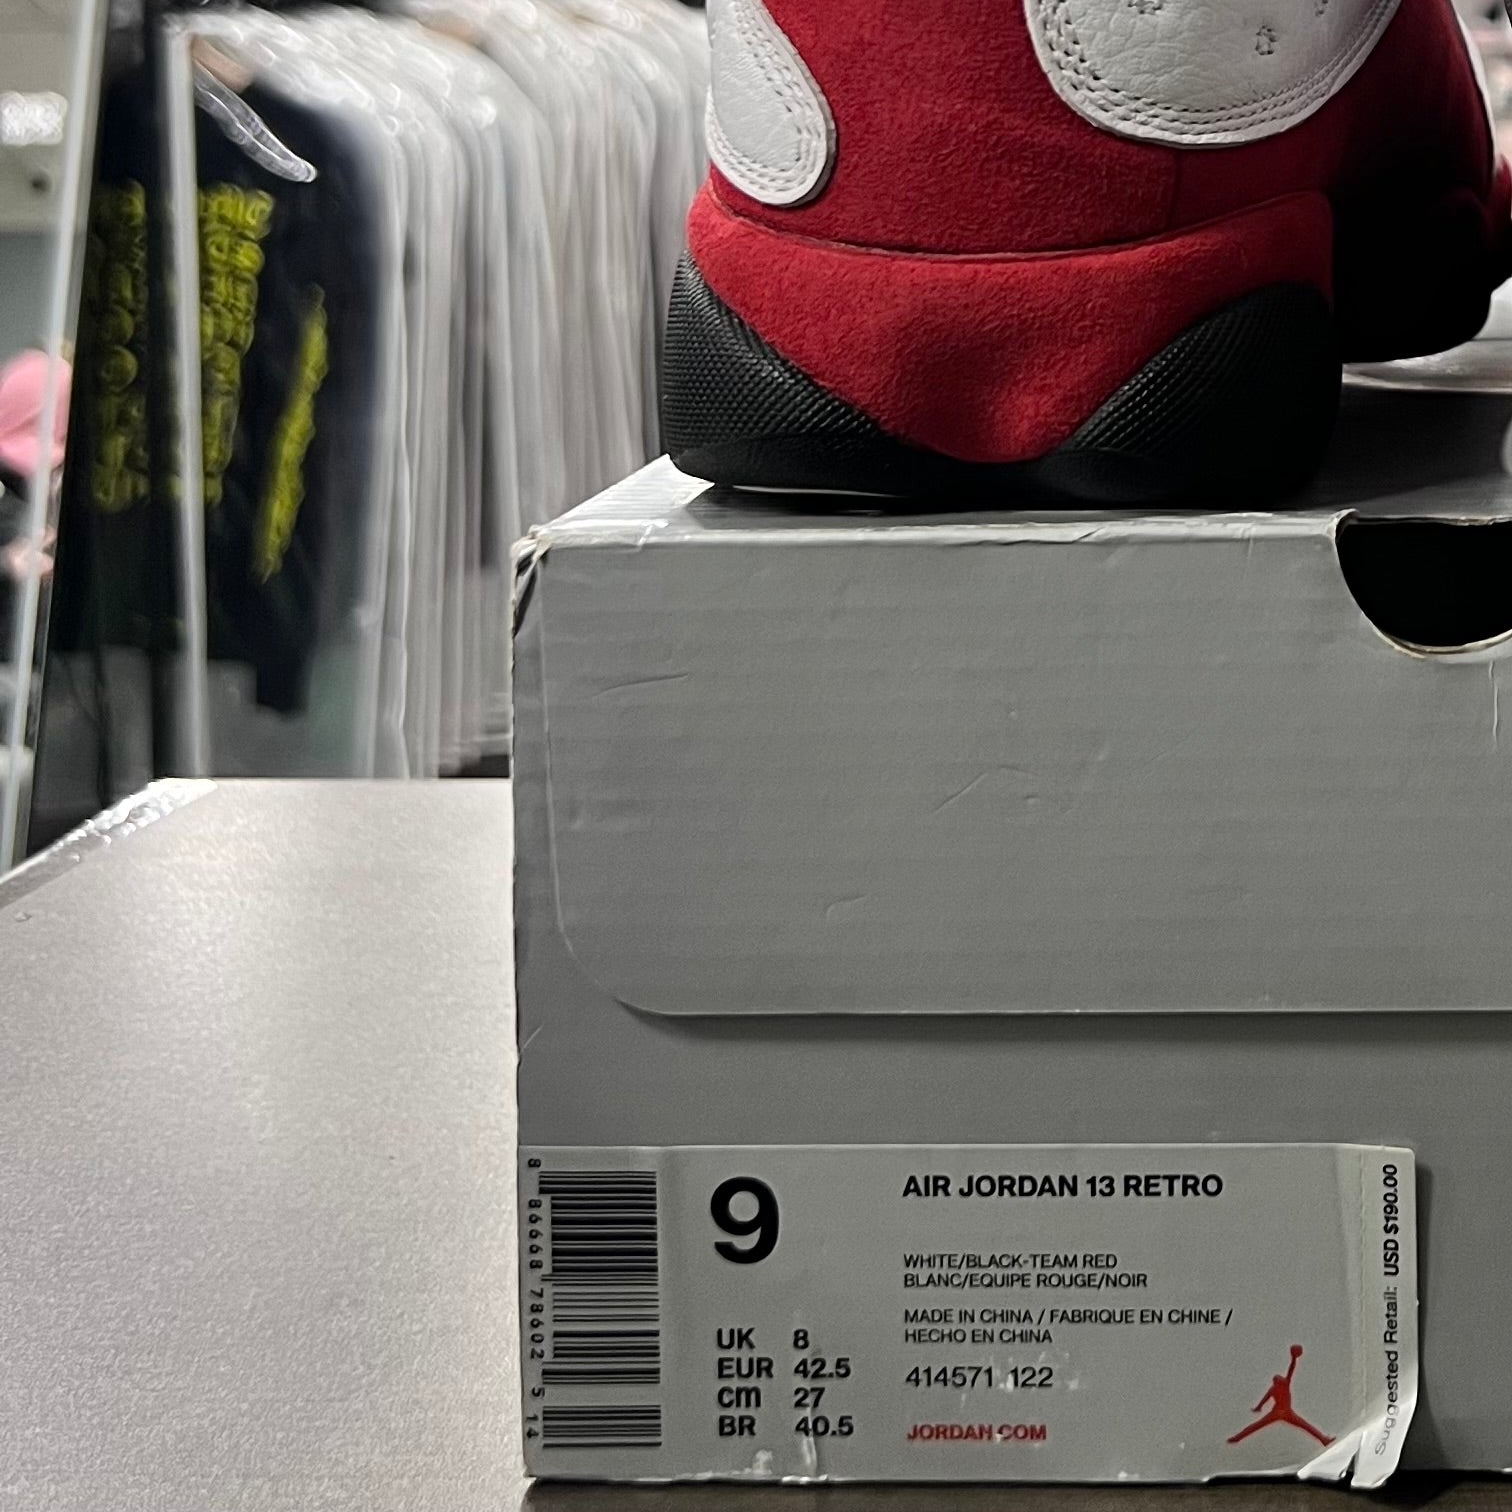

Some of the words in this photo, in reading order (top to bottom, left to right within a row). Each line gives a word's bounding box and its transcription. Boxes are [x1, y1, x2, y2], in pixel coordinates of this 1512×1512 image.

[527, 1158, 542, 1168] 8
[902, 1175, 951, 1198] AIR
[959, 1175, 1078, 1198] JORDAN
[1086, 1175, 1115, 1198] 13
[1124, 1174, 1223, 1198] RETRO
[1382, 1164, 1399, 1235] $190.00
[710, 1176, 780, 1265] 9
[528, 1198, 544, 1269] 86668
[904, 1253, 1078, 1270] WHITE/BLACK-TEAM
[1083, 1253, 1118, 1269] RED
[1383, 1239, 1399, 1277] USD
[904, 1273, 1031, 1290] BLANC/EQUIPE
[1037, 1272, 1148, 1289] ROUGE/NOIR
[530, 1288, 545, 1360] 78602
[904, 1308, 954, 1324] MADE
[958, 1308, 976, 1324] IN
[980, 1308, 1033, 1324] CHINA
[1037, 1308, 1046, 1326] /
[1050, 1308, 1135, 1325] FABRIQUE
[1140, 1308, 1163, 1324] EN
[1168, 1308, 1220, 1324] CHINE
[1224, 1308, 1234, 1326] /
[1383, 1286, 1399, 1345] Retail:
[716, 1328, 756, 1350] UK
[793, 1329, 809, 1350] 8
[905, 1328, 967, 1344] HECHO
[971, 1328, 995, 1344] EN
[999, 1328, 1053, 1344] CHINA
[717, 1357, 774, 1380] EUR
[794, 1357, 851, 1380] 42.5
[905, 1366, 993, 1388] 414571
[1006, 1366, 1054, 1388] 122
[531, 1387, 545, 1398] 5
[717, 1386, 761, 1409] cm
[794, 1387, 826, 1409] 27
[1374, 1350, 1399, 1456] Suggested
[526, 1414, 540, 1439] 14
[718, 1415, 757, 1437] BR
[795, 1415, 854, 1437] 40.5
[907, 1424, 1047, 1441] JORDANCOM
